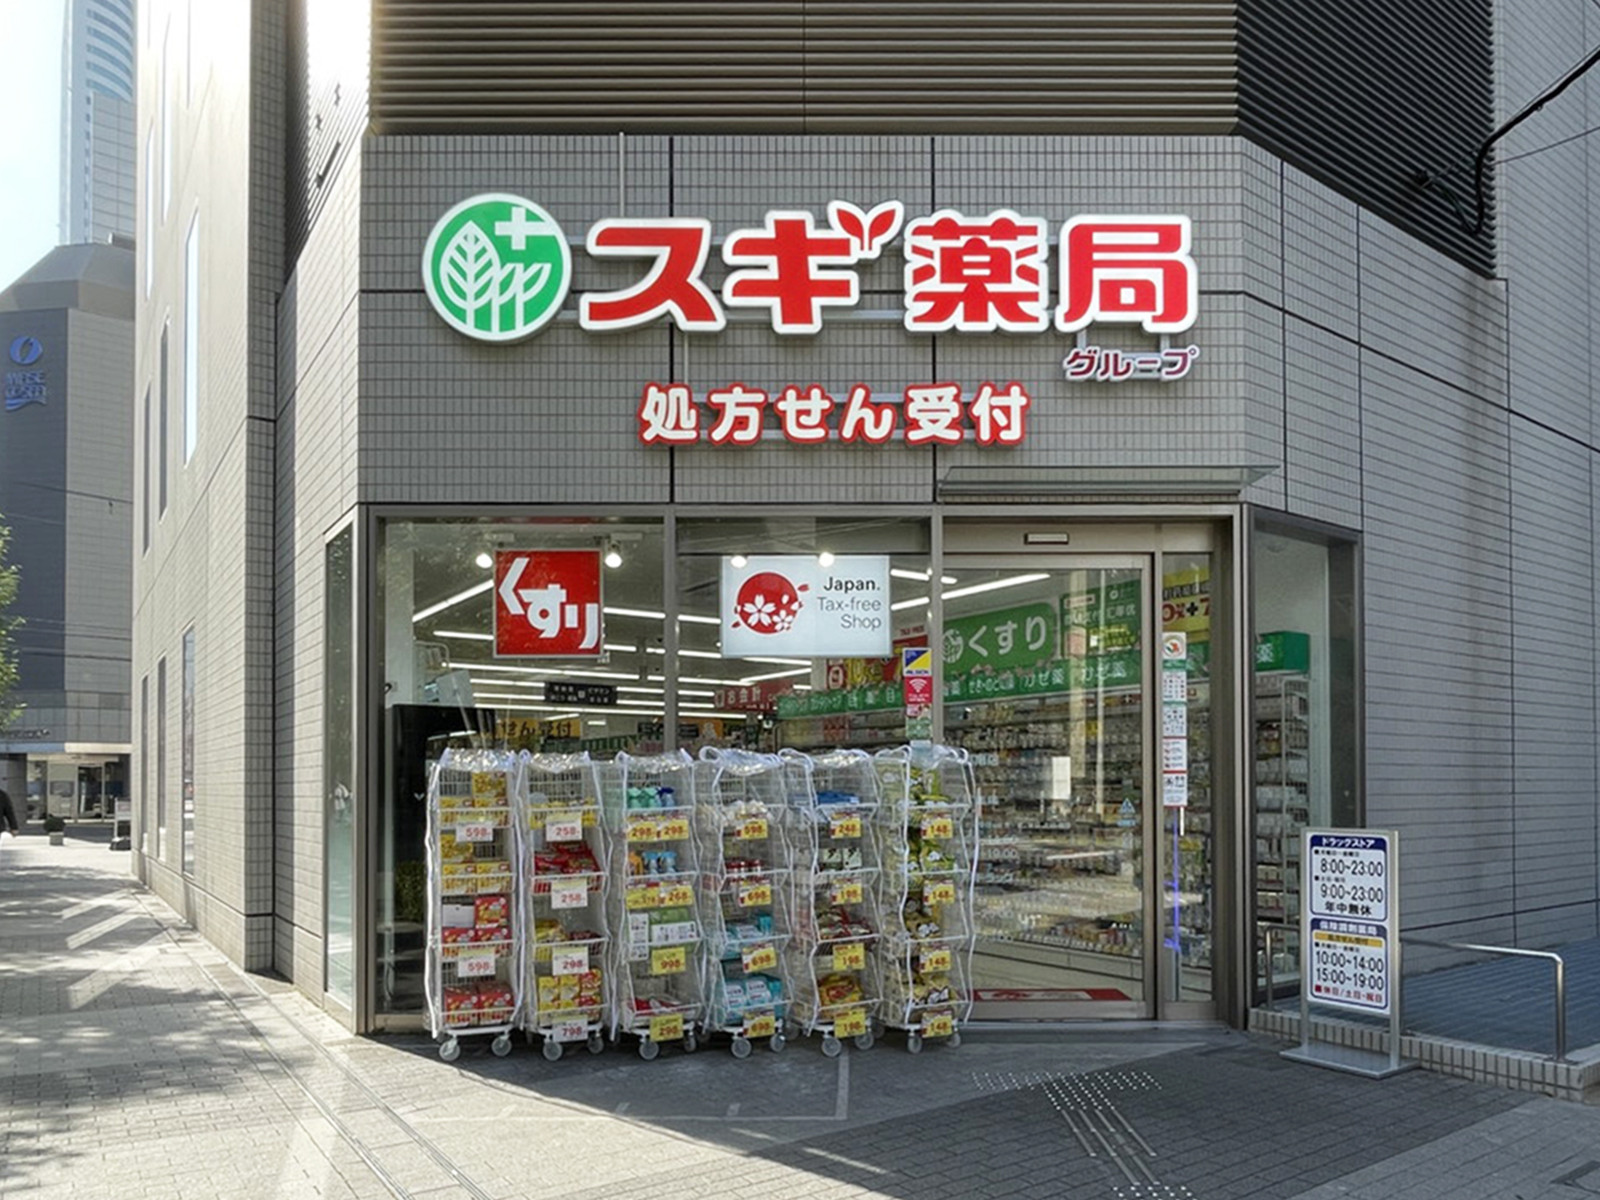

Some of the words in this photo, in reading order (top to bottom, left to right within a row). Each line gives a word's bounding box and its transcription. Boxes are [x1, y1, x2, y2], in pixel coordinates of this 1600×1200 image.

[580, 200, 1198, 334] スギ薬局
[1064, 344, 1198, 382] グループ
[639, 382, 1028, 447] 処方せん受付
[498, 556, 600, 650] くすり
[817, 596, 882, 613] Tax-free
[840, 614, 882, 631] Shop
[968, 615, 1047, 657] くすり
[1325, 901, 1372, 916] 年中無休
